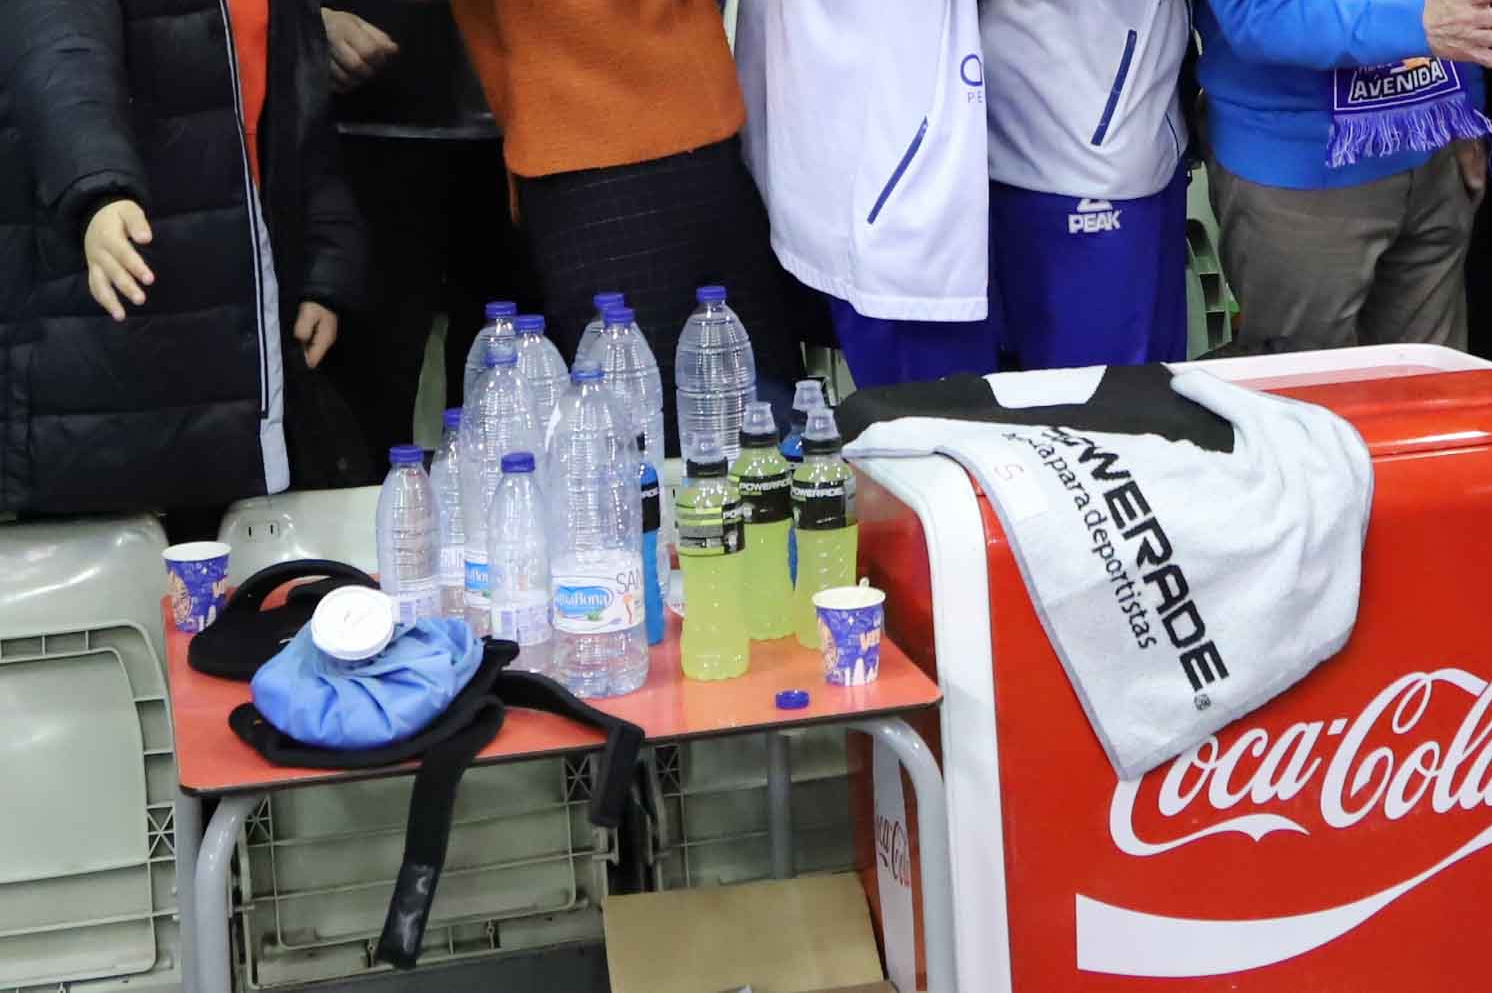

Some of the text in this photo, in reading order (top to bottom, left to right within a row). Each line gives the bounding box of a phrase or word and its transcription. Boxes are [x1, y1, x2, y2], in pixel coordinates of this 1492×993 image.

[1352, 61, 1447, 102] AVENIDA
[1068, 210, 1122, 234] PEAK
[1045, 457, 1158, 650] para deportistas
